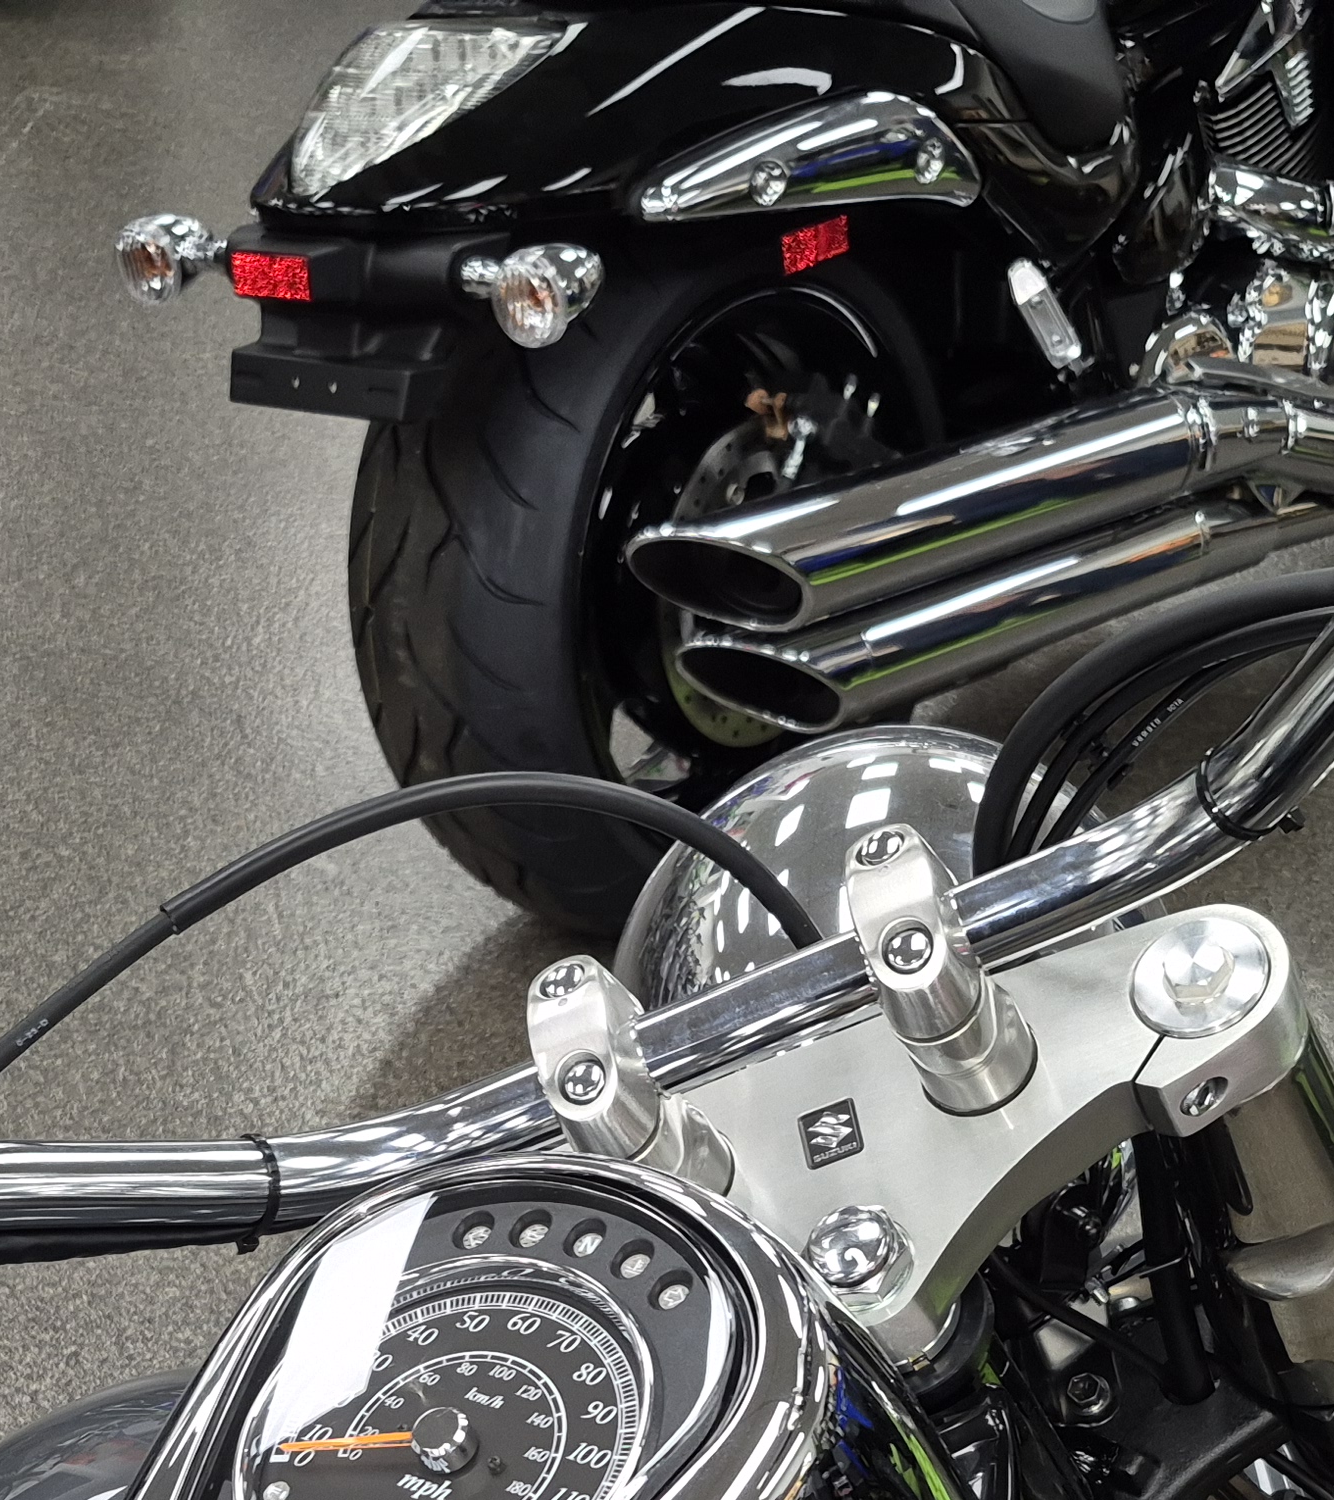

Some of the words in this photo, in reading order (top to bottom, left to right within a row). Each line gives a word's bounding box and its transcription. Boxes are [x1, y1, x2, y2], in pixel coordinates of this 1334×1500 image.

[812, 1141, 858, 1163] SUZUKI
[581, 1234, 603, 1253] N
[456, 1311, 491, 1334] 50
[507, 1313, 543, 1337] 60
[405, 1324, 440, 1348] 40
[546, 1329, 582, 1354] 70
[418, 1371, 442, 1387] 60
[455, 1362, 479, 1377] 80
[488, 1364, 517, 1382] 100
[572, 1362, 607, 1387] 80
[383, 1394, 407, 1411] 40
[464, 1387, 506, 1410] km/h
[515, 1385, 544, 1401] 120
[525, 1412, 555, 1430] 140
[581, 1400, 618, 1426] 90
[302, 1424, 333, 1443] 10
[523, 1447, 550, 1464] 160
[566, 1443, 612, 1471] 100
[506, 1479, 532, 1497] 180
